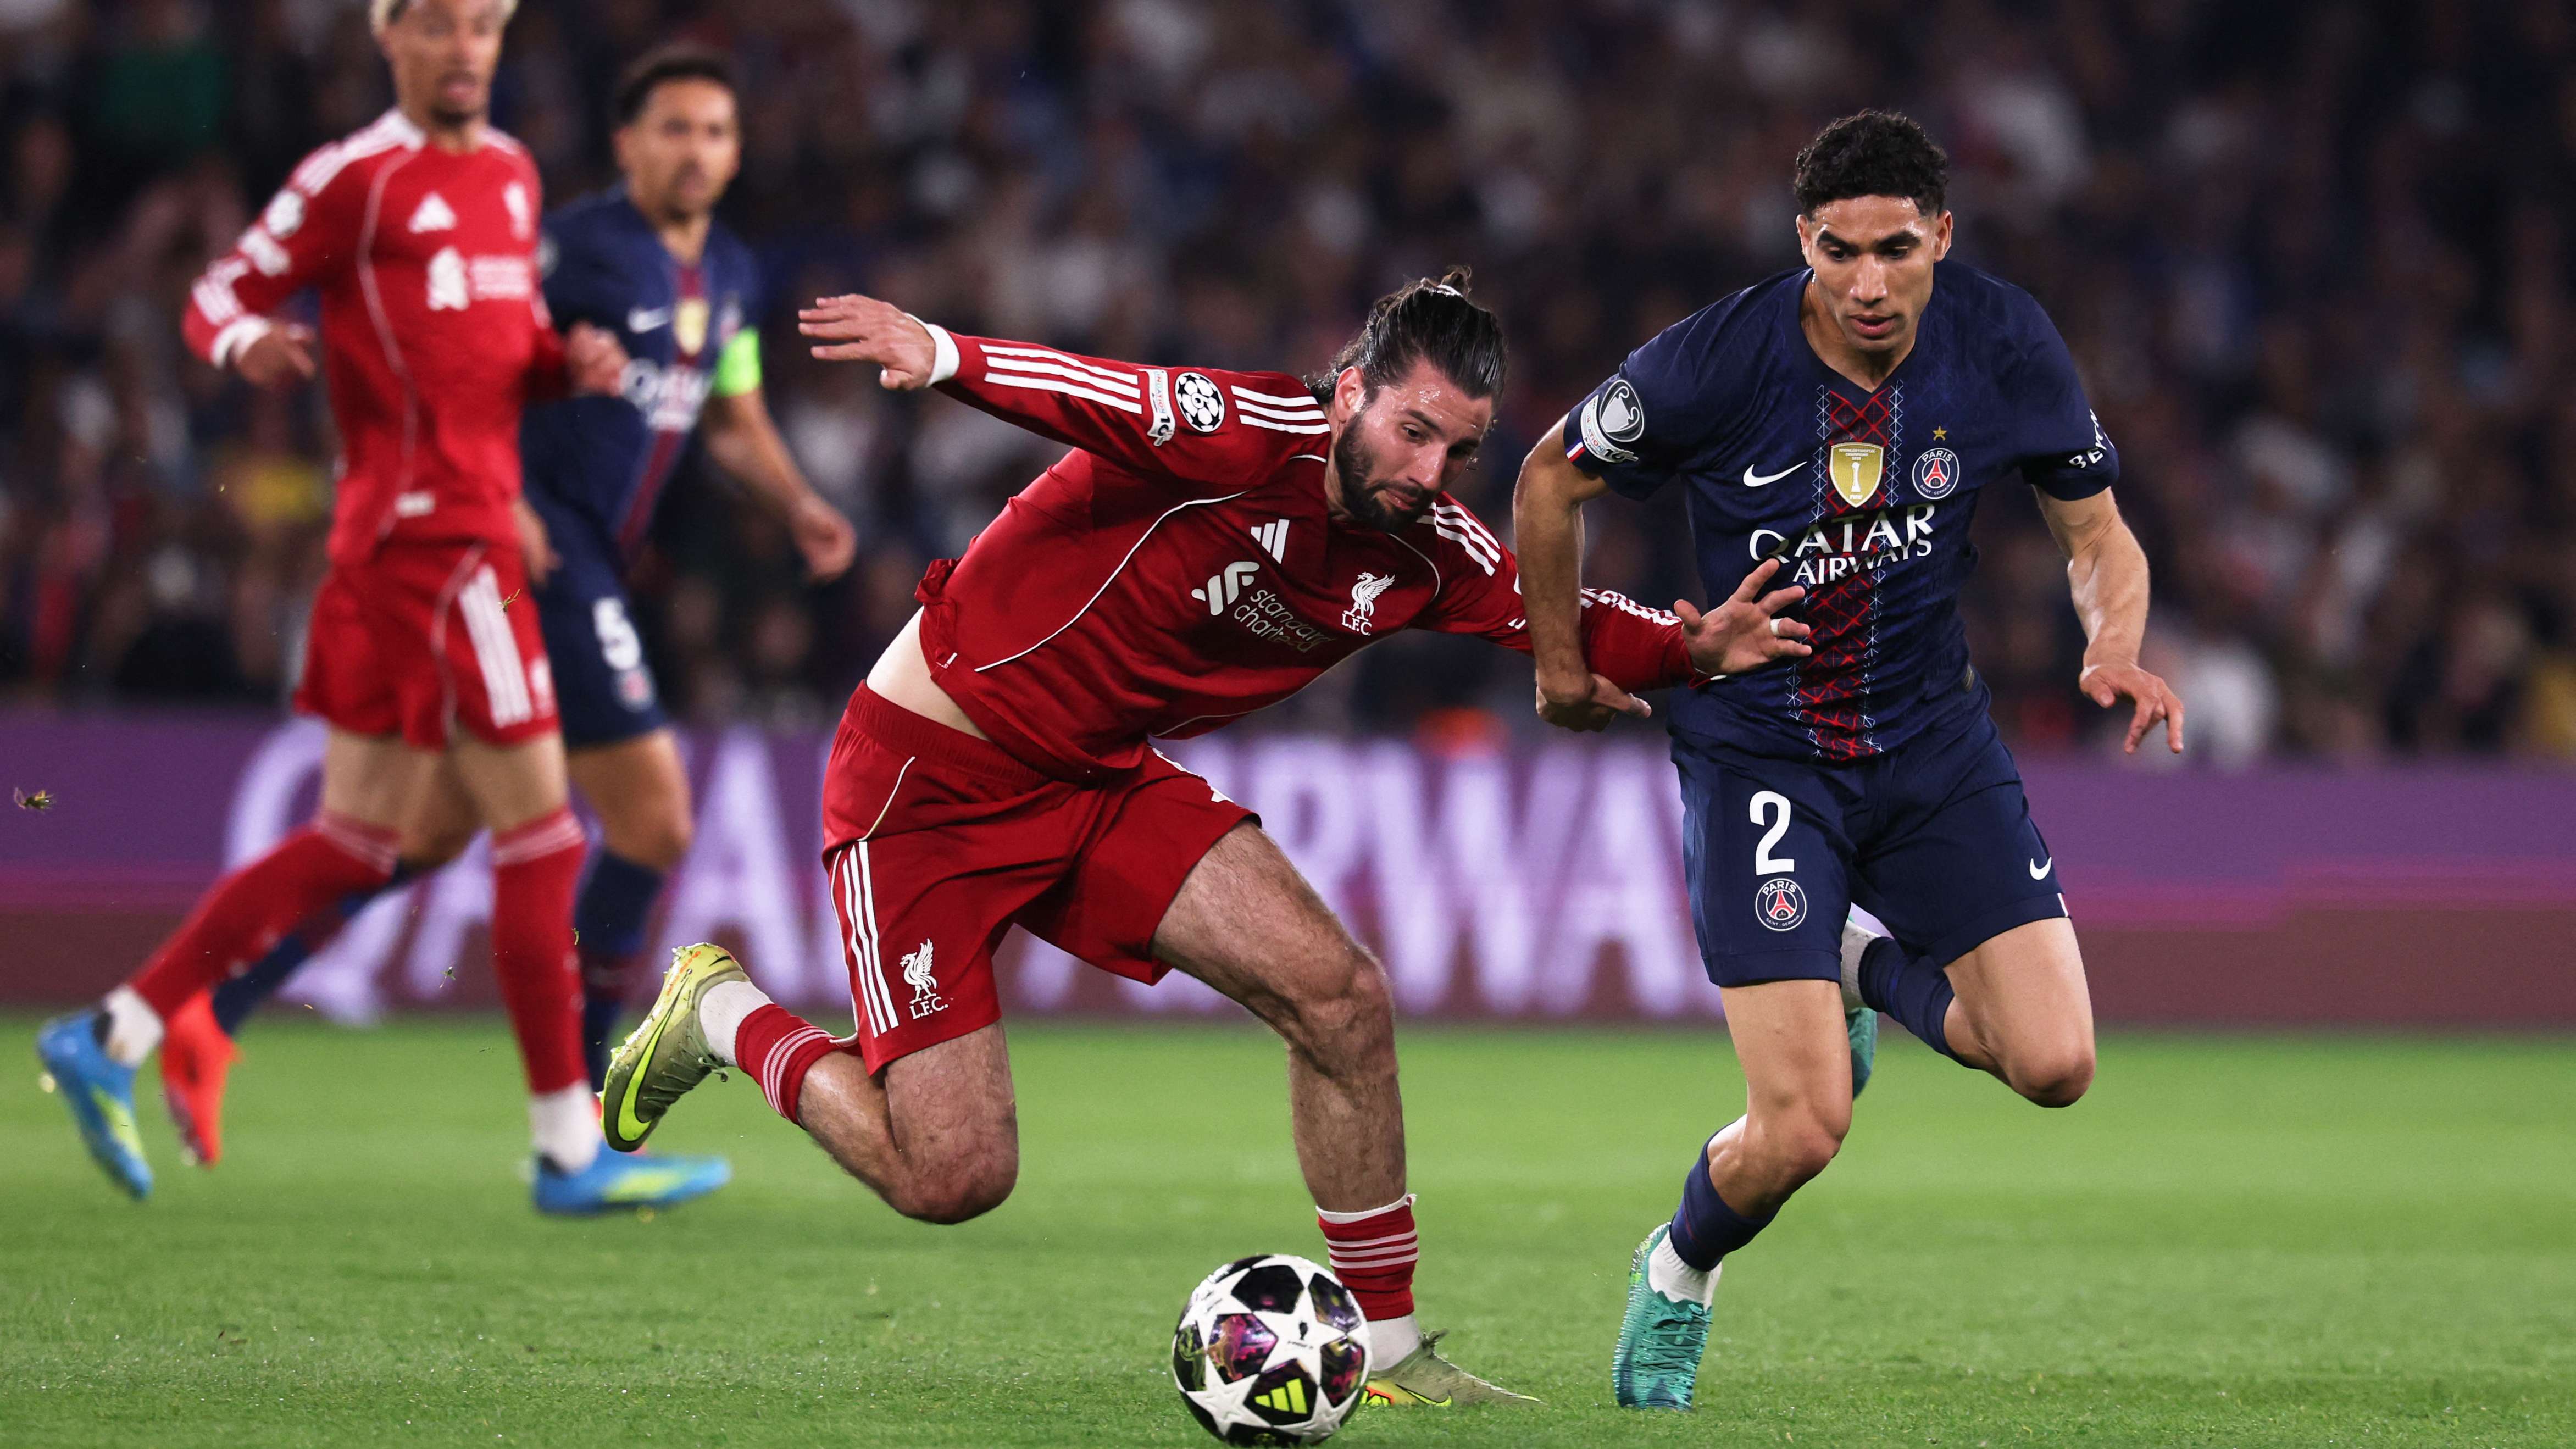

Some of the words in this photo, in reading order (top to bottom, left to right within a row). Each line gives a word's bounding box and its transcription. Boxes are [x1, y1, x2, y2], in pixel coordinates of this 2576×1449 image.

[1922, 451, 1953, 462] PARIS
[1749, 503, 1935, 564] QATAR
[1792, 538, 1932, 584] AIRWAYS
[592, 598, 640, 670] 5
[1750, 791, 1794, 875] 2
[1762, 881, 1796, 895] PARIS
[909, 997, 948, 1019] L.F.C.
